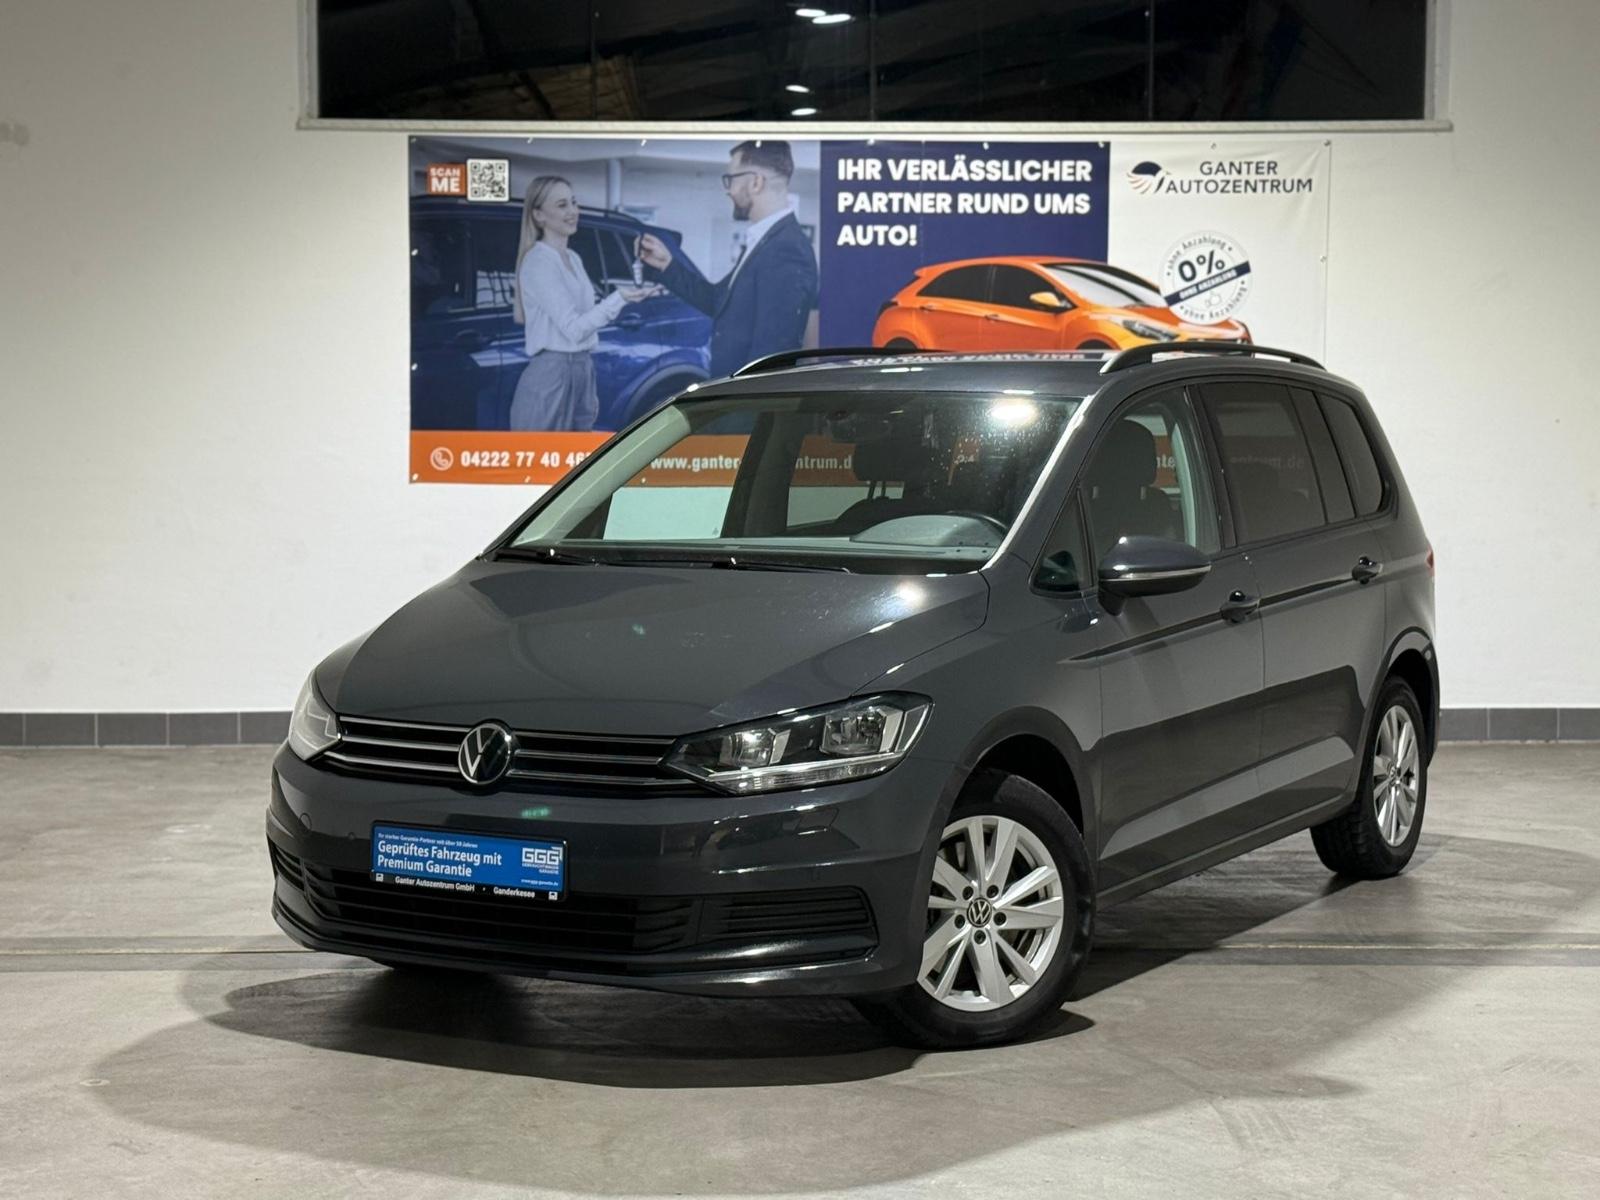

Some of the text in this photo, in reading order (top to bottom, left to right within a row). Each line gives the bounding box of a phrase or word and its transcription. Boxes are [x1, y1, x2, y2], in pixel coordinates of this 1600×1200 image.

[430, 167, 460, 177] SCAN
[837, 154, 1092, 181] IHR VERLÄSSLICHER
[1199, 161, 1278, 175] GANTER
[431, 177, 460, 192] ME
[1165, 178, 1313, 194] AUTOZENTRUM
[837, 192, 1091, 214] PARTNER RUND UMS
[837, 225, 918, 246] AUTO!
[1178, 250, 1225, 282] 0%
[461, 450, 592, 467] 04222 77 40 46
[378, 840, 429, 857] Geprüftes
[431, 846, 480, 866] Fahrzeug
[483, 852, 502, 866] mit
[522, 847, 560, 865] GGG
[377, 854, 472, 877] Premium Garantie
[395, 876, 536, 898] Ganter Autozentrum GmbH Ganderkesee
